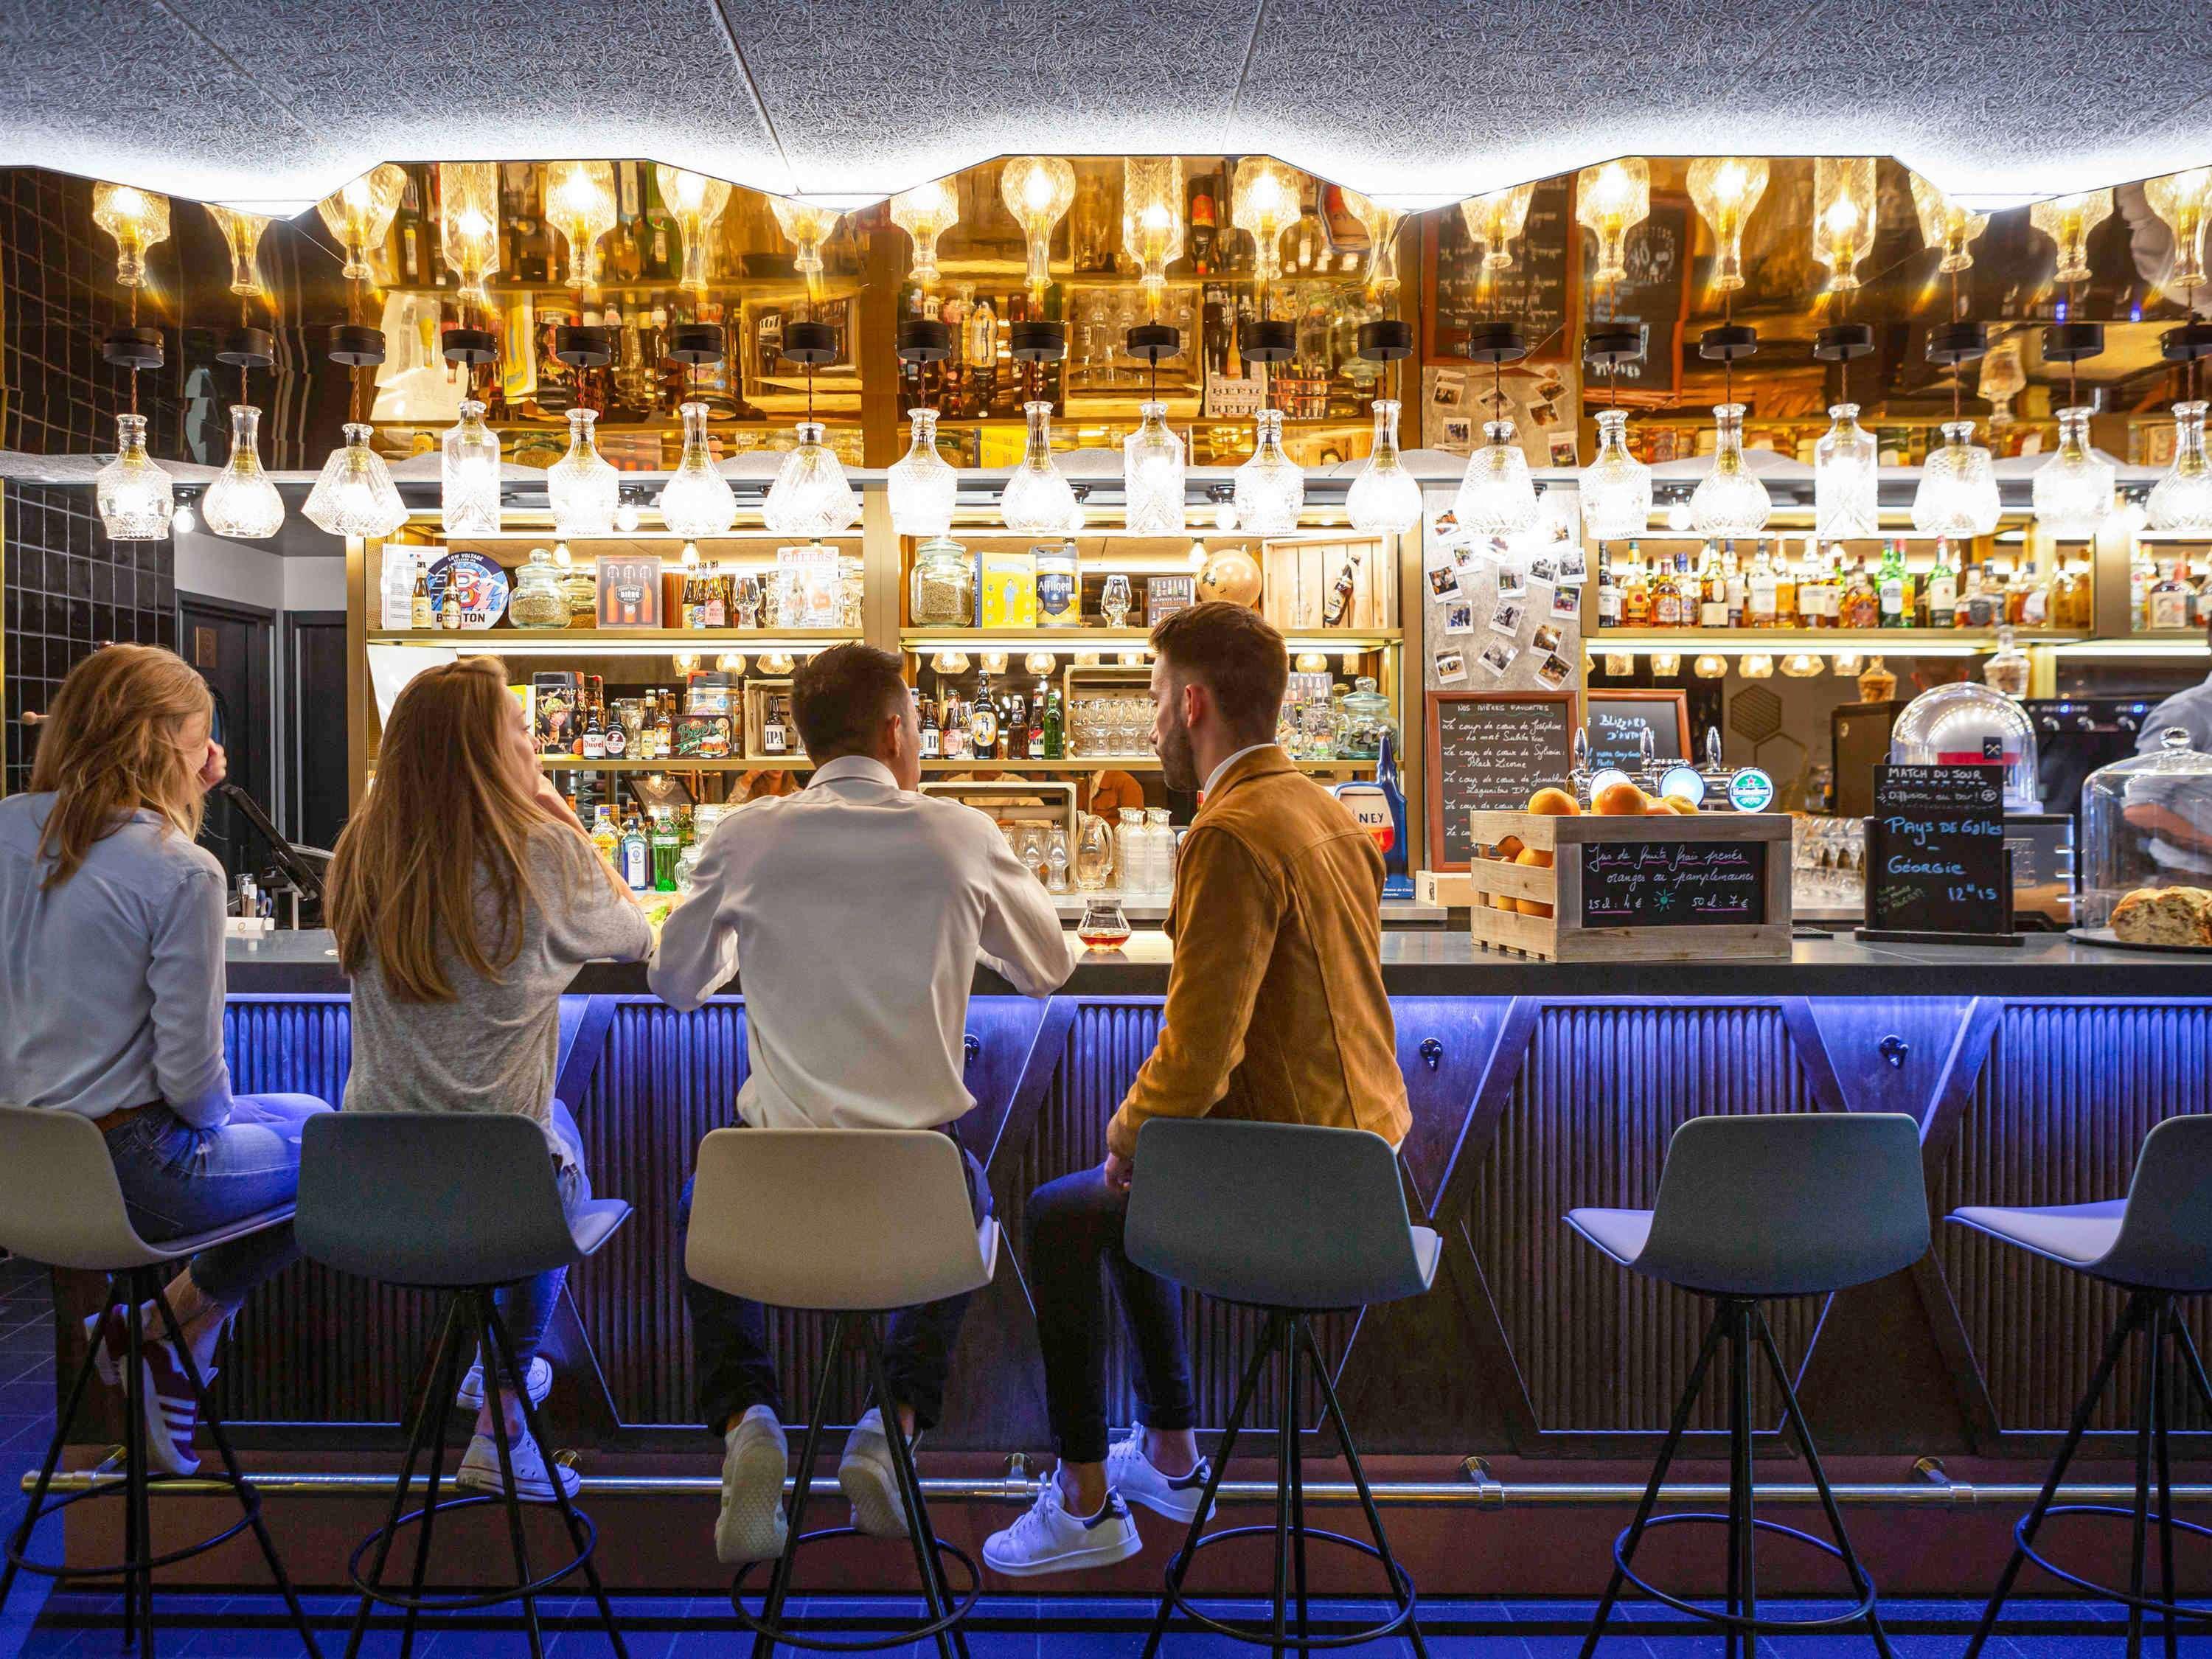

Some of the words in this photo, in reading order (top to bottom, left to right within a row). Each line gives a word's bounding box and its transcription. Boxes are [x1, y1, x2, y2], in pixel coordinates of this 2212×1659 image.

[461, 553, 484, 561] VOLTAGE
[783, 553, 832, 562] CHEERS
[437, 613, 485, 622] BTON
[1484, 720, 1493, 730] de
[1520, 721, 1528, 730] de
[766, 731, 784, 744] IPA
[585, 740, 604, 748] Duvel
[1484, 747, 1492, 756] de
[1520, 748, 1529, 756] de
[1888, 768, 1927, 779] MATCH
[1934, 770, 1949, 778] DU
[1952, 770, 1983, 779] JOUR
[1482, 774, 1492, 783] de
[1521, 774, 1530, 783] de
[1511, 787, 1531, 795] IPA
[1481, 801, 1490, 810] de
[1587, 843, 1612, 872] Jus
[1618, 848, 1630, 860] de
